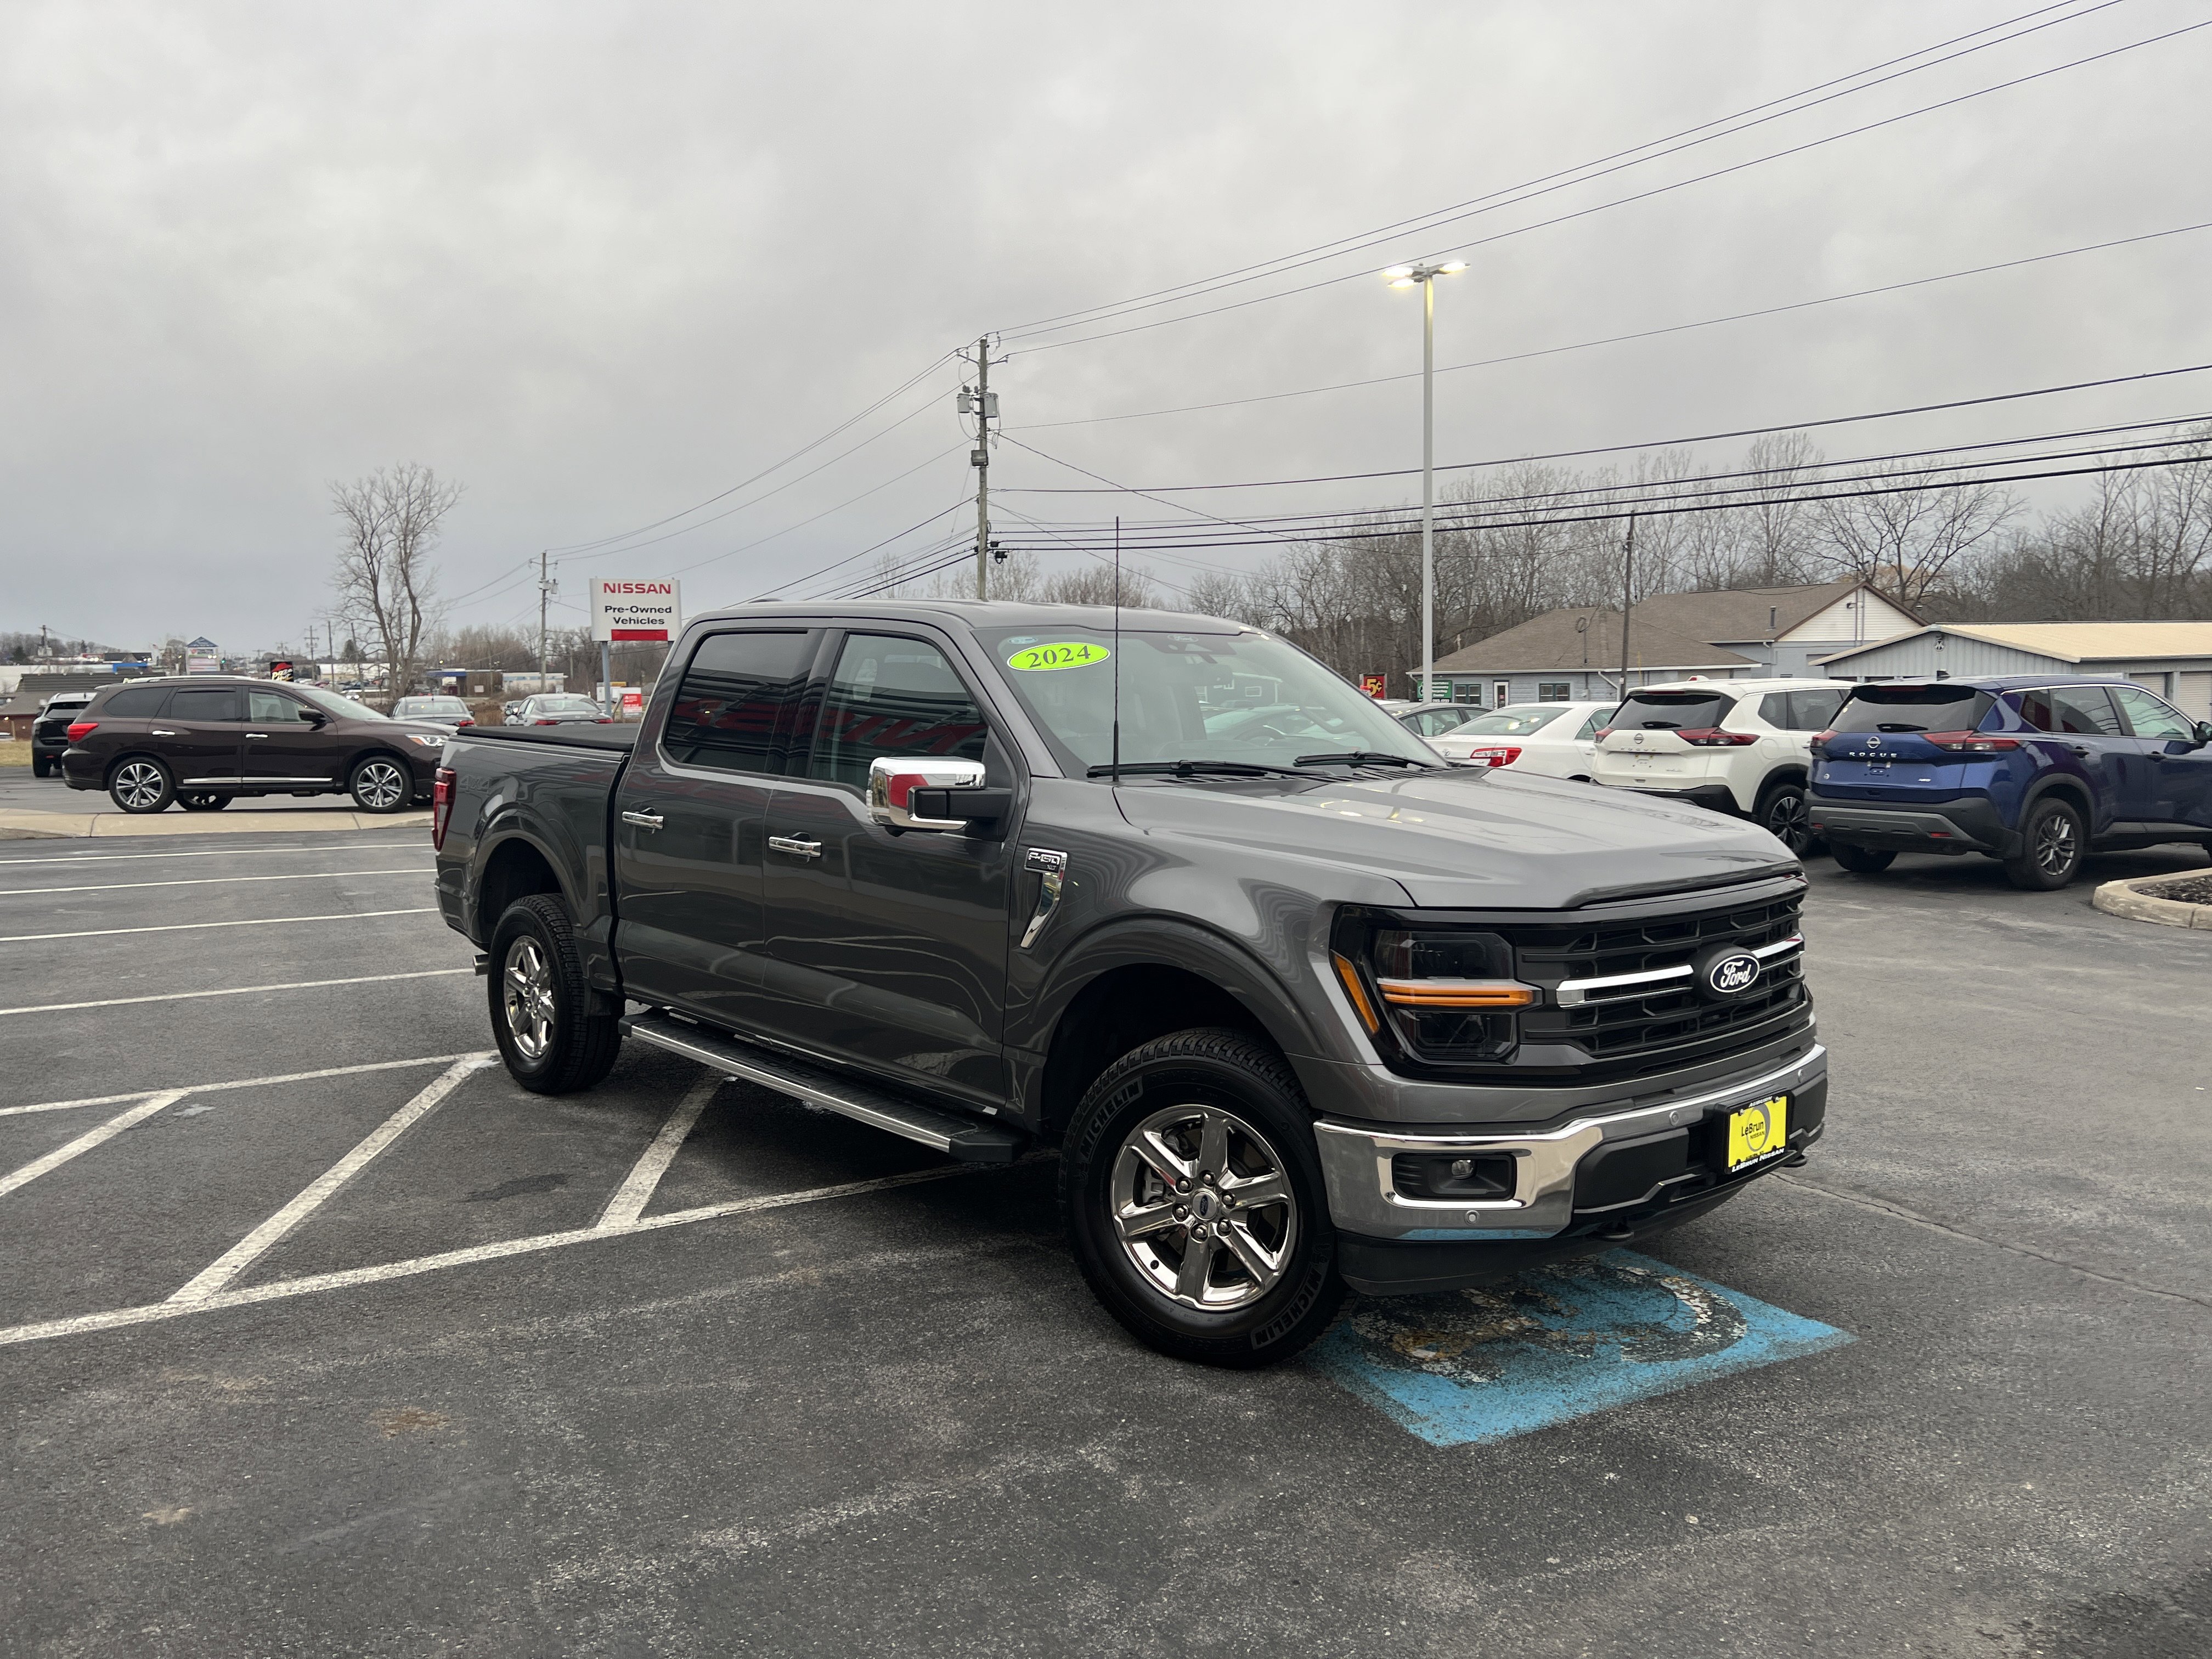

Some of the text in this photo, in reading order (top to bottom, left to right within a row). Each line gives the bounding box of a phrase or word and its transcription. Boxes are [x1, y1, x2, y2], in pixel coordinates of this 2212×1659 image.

[603, 583, 671, 594] NISSAN
[1026, 645, 1091, 668] 2024
[1366, 678, 1382, 696] 5¢
[1028, 852, 1060, 865] F-150
[1720, 960, 1752, 988] Ford
[1080, 1080, 1139, 1159] MICHELIN
[1741, 1121, 1764, 1137] LeBrun
[1759, 1148, 1784, 1161] NISSAN
[1255, 1266, 1322, 1345] MICHELIN
